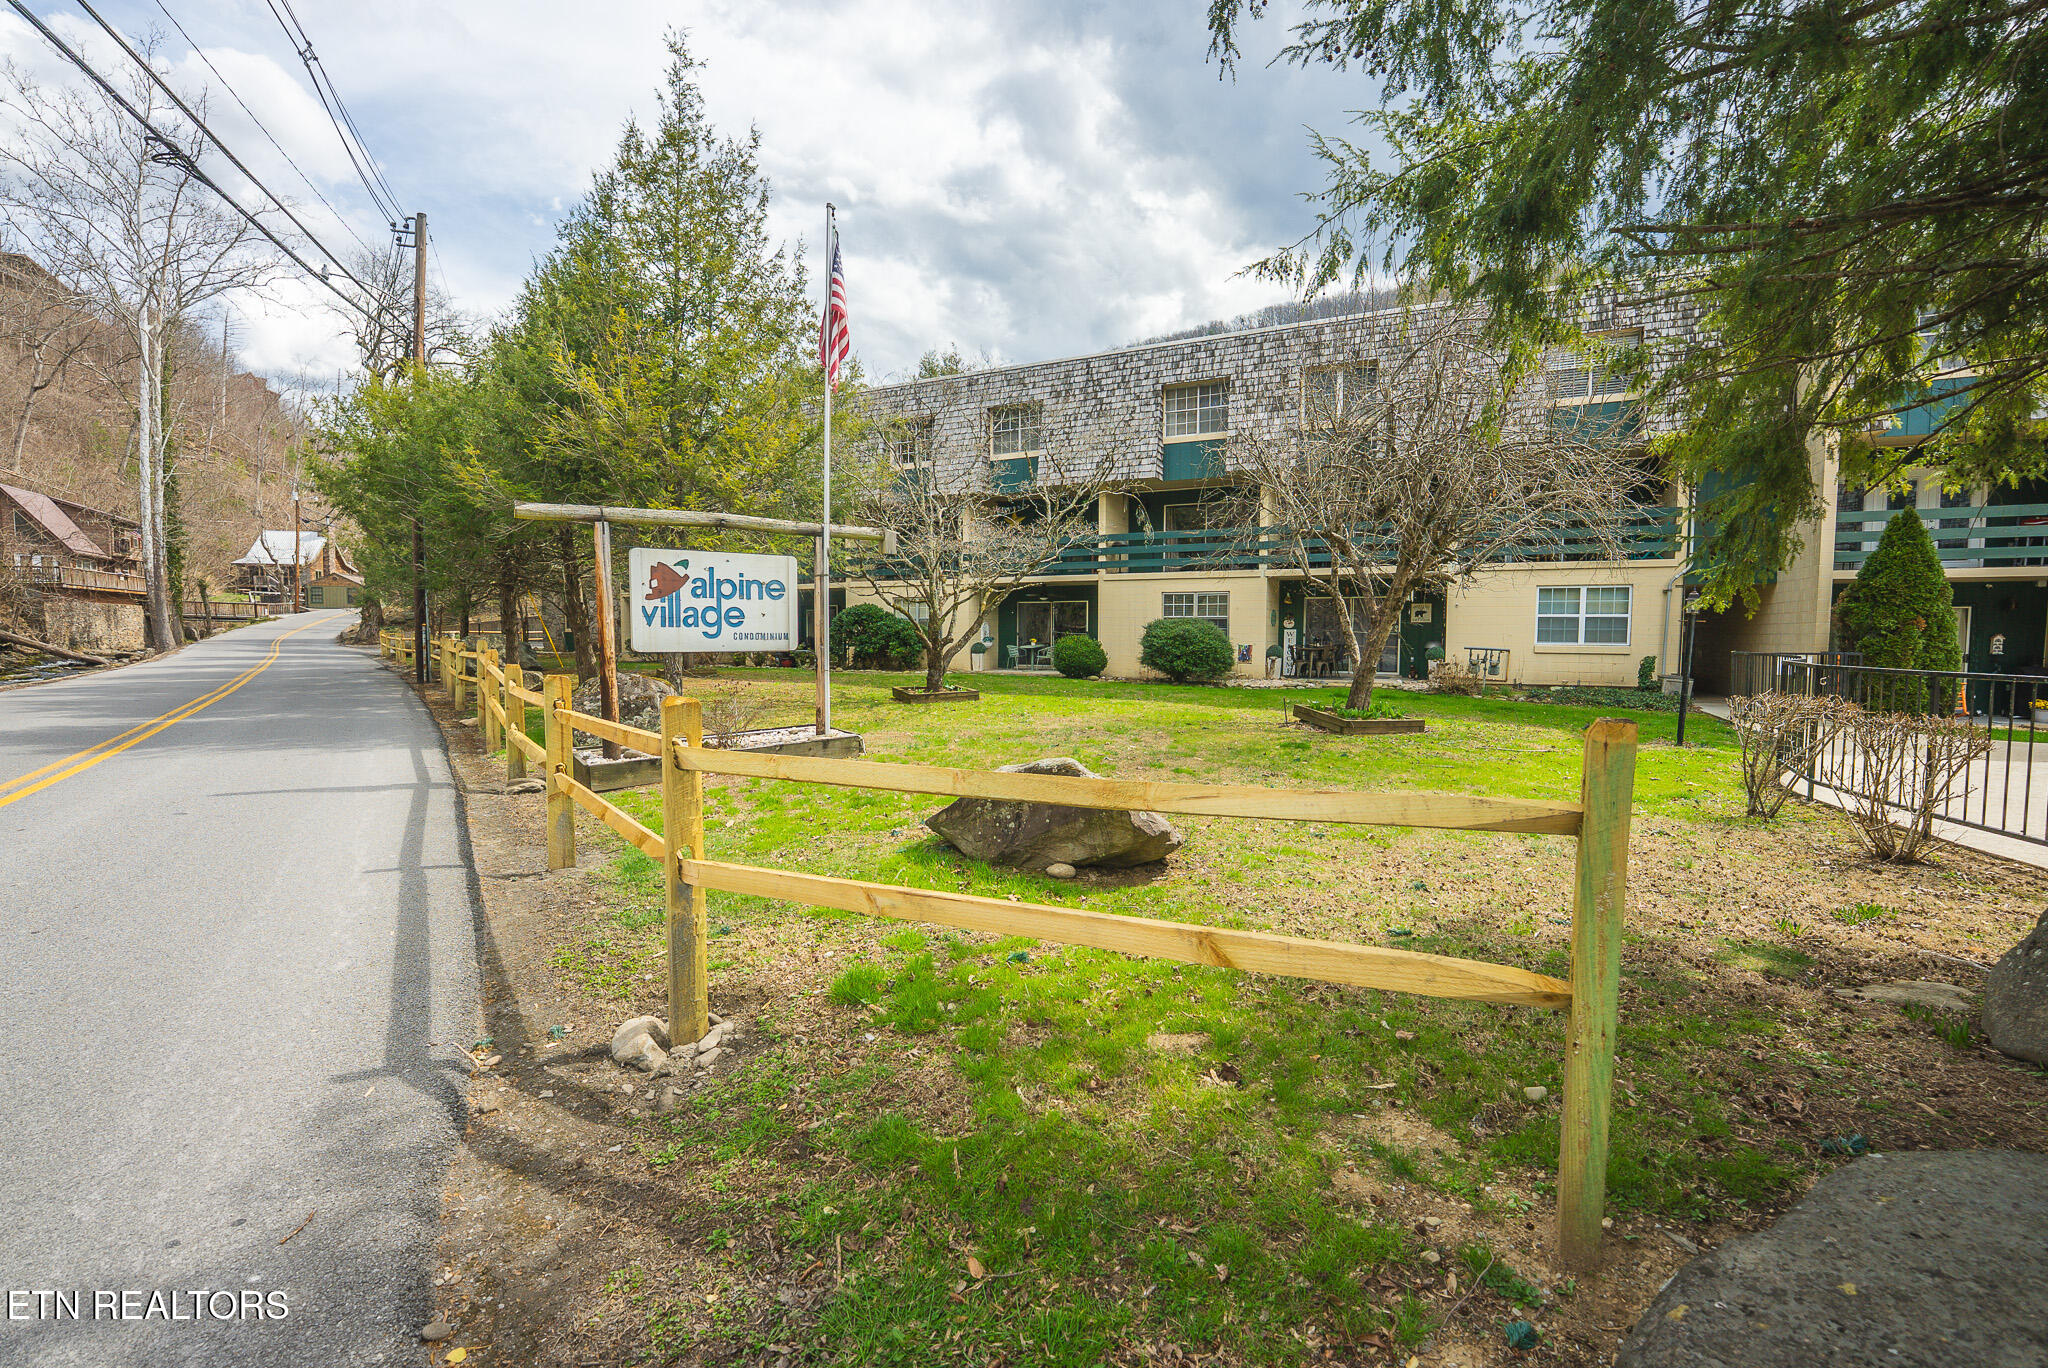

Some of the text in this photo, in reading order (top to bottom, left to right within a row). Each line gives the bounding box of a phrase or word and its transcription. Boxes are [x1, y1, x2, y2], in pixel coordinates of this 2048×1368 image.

[690, 566, 786, 602] alpine
[641, 591, 746, 639] village
[733, 632, 789, 641] CONDOMINIUM
